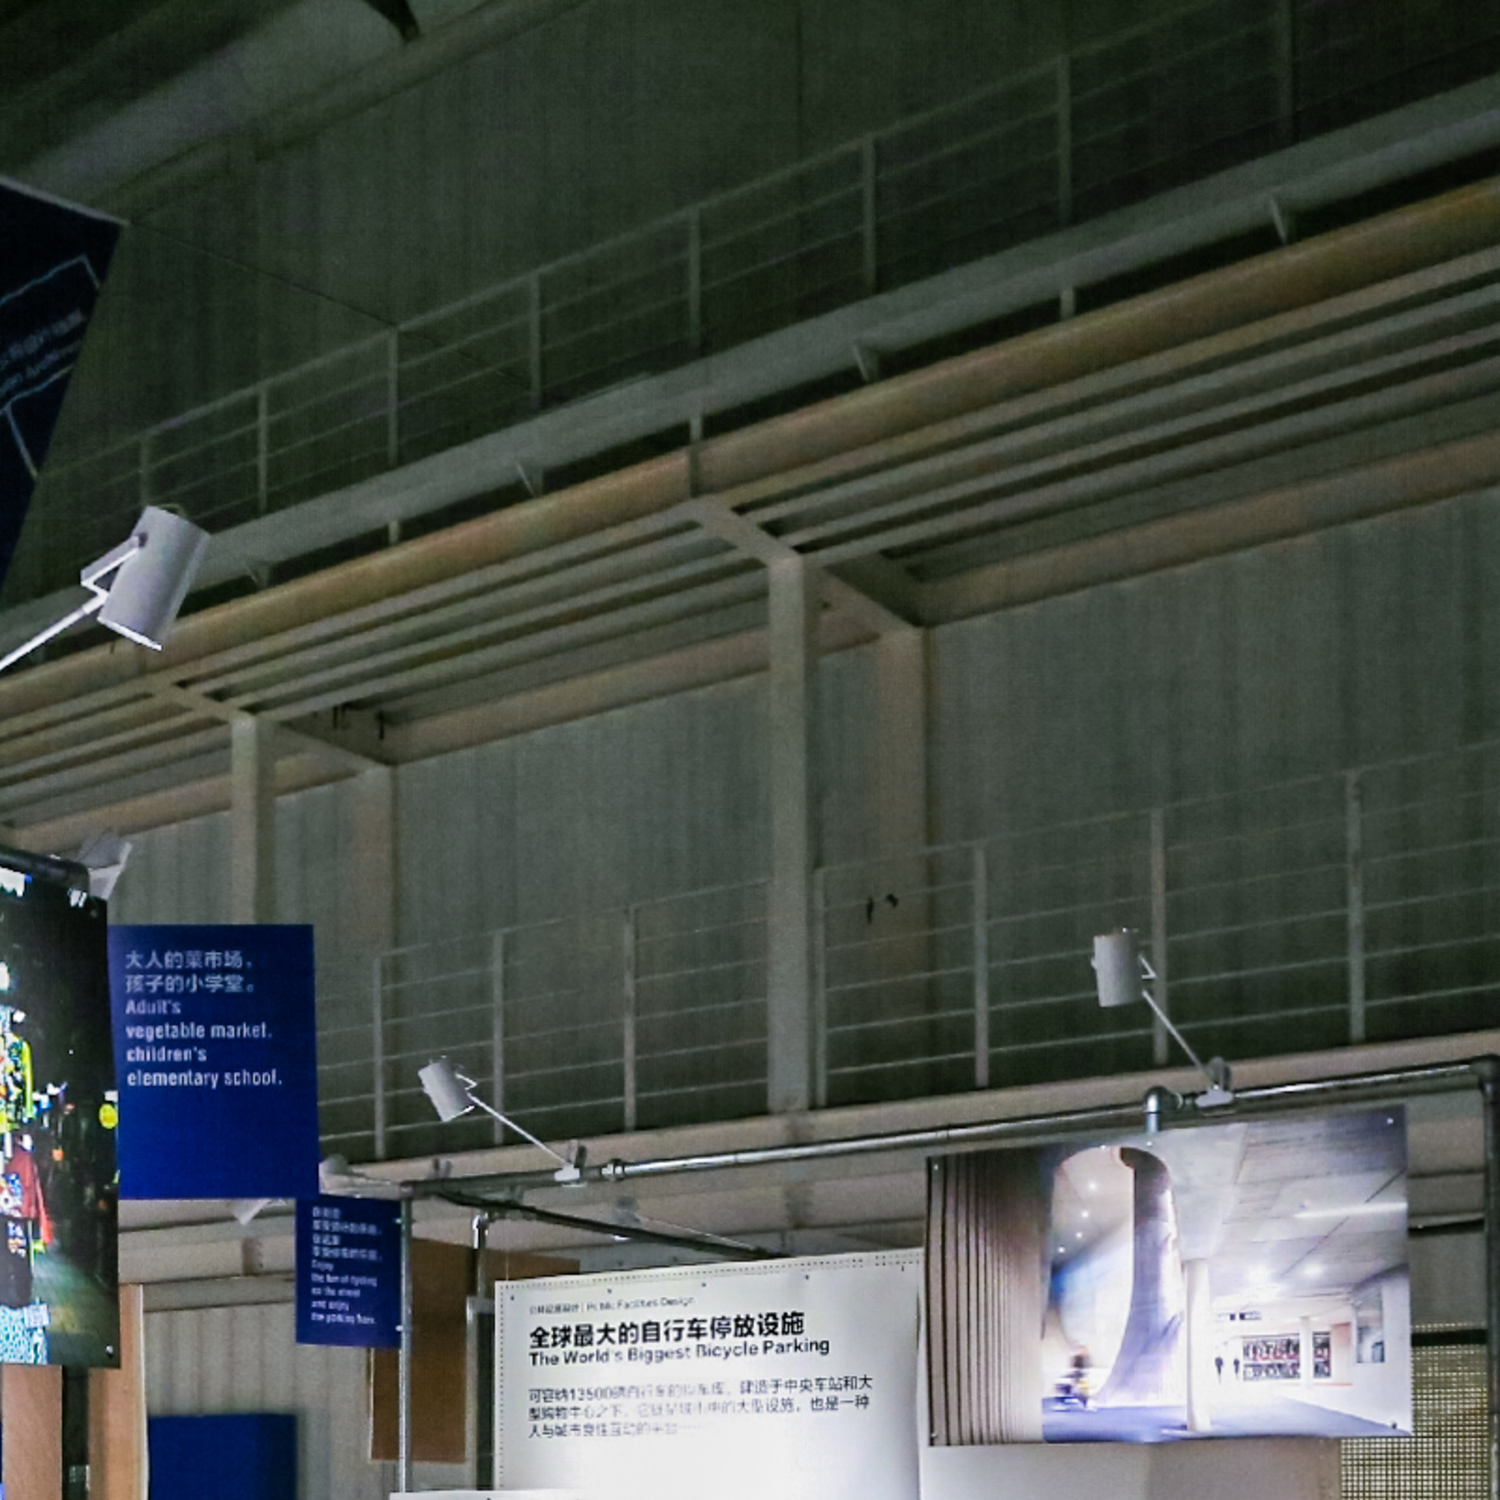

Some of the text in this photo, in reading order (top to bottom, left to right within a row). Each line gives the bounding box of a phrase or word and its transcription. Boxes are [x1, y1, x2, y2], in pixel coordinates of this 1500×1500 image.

[125, 973, 254, 993] 孩子的小学堂。
[125, 999, 182, 1015] Adult's
[125, 1021, 206, 1043] vegetable
[126, 1045, 208, 1063] children's
[127, 1068, 283, 1090] elementary school.
[529, 1310, 805, 1350] 全球最大的自行车停放设施
[529, 1337, 830, 1368] The World's Biggest Bicycle Parking
